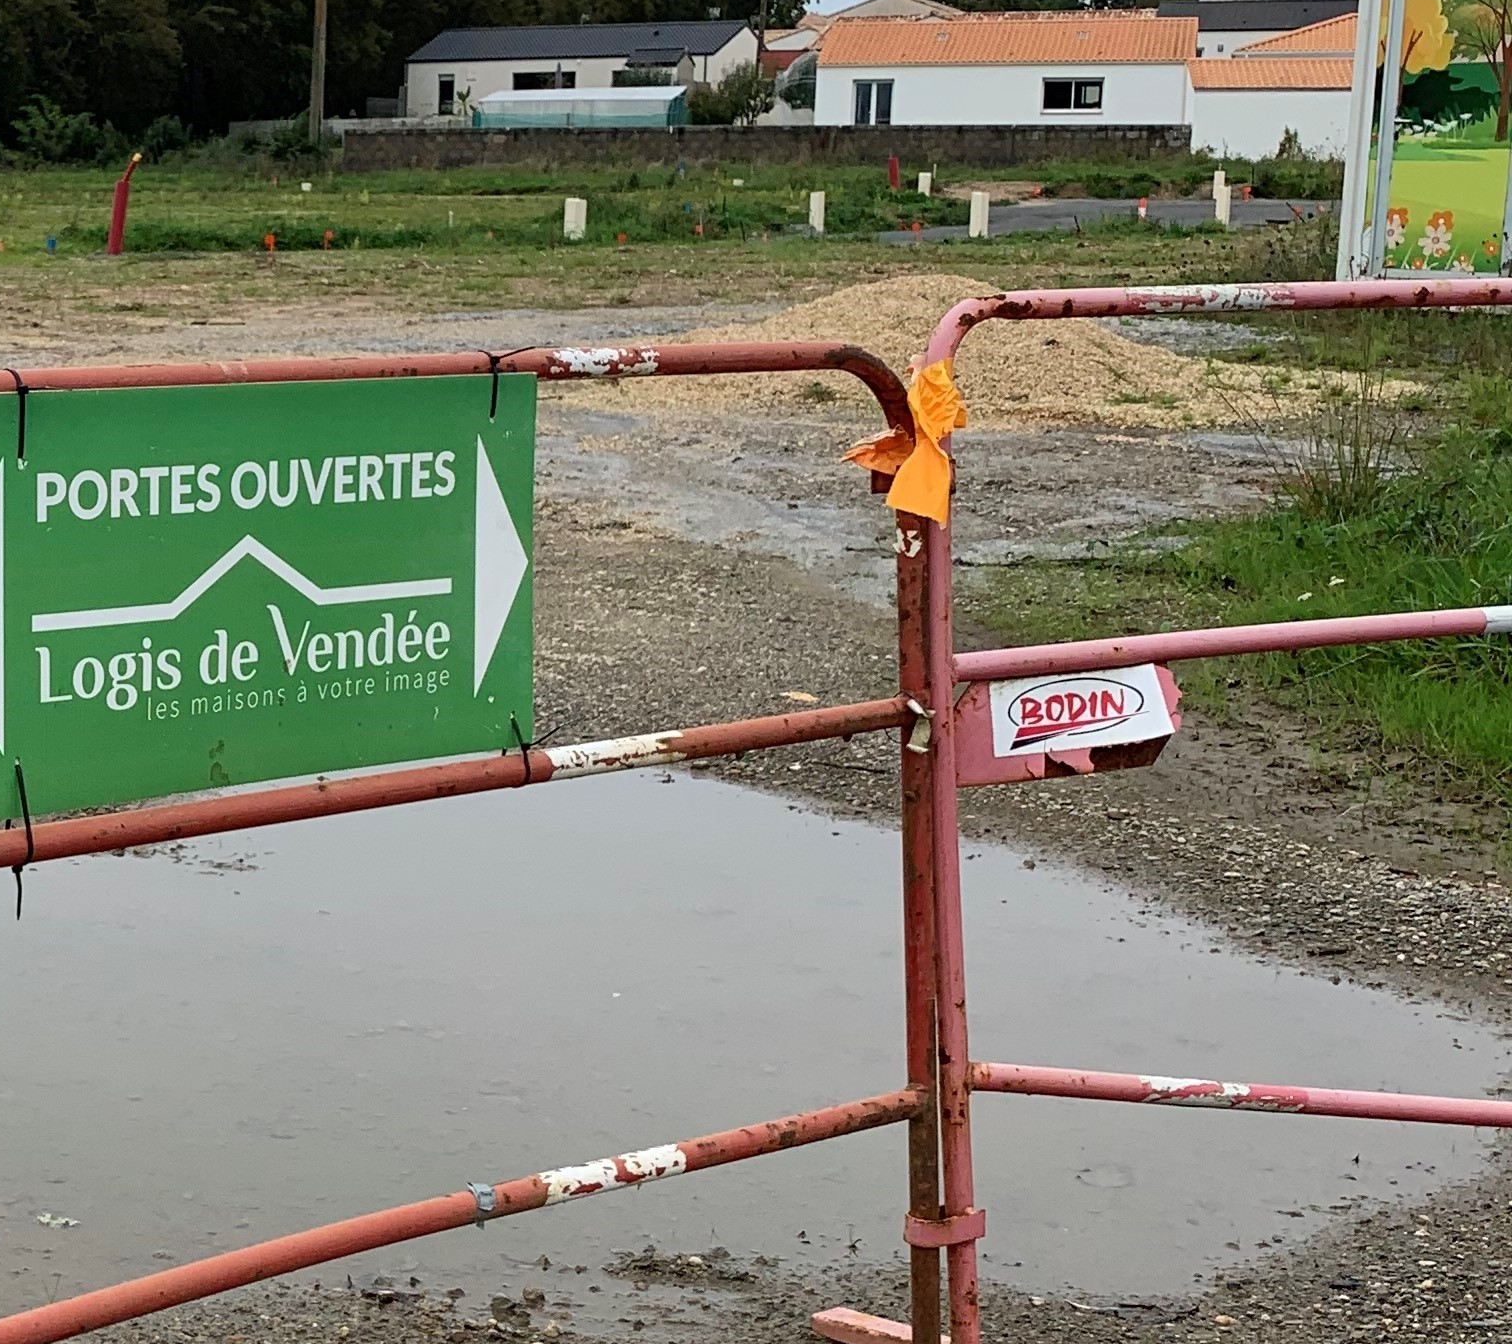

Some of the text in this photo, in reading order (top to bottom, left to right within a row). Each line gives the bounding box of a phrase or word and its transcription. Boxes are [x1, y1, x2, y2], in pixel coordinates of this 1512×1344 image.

[35, 450, 457, 523] PORTES OUVERTES
[34, 604, 452, 712] Logis de Vendée
[146, 667, 451, 721] les maisons à votre image
[1020, 688, 1125, 725] BODIN
